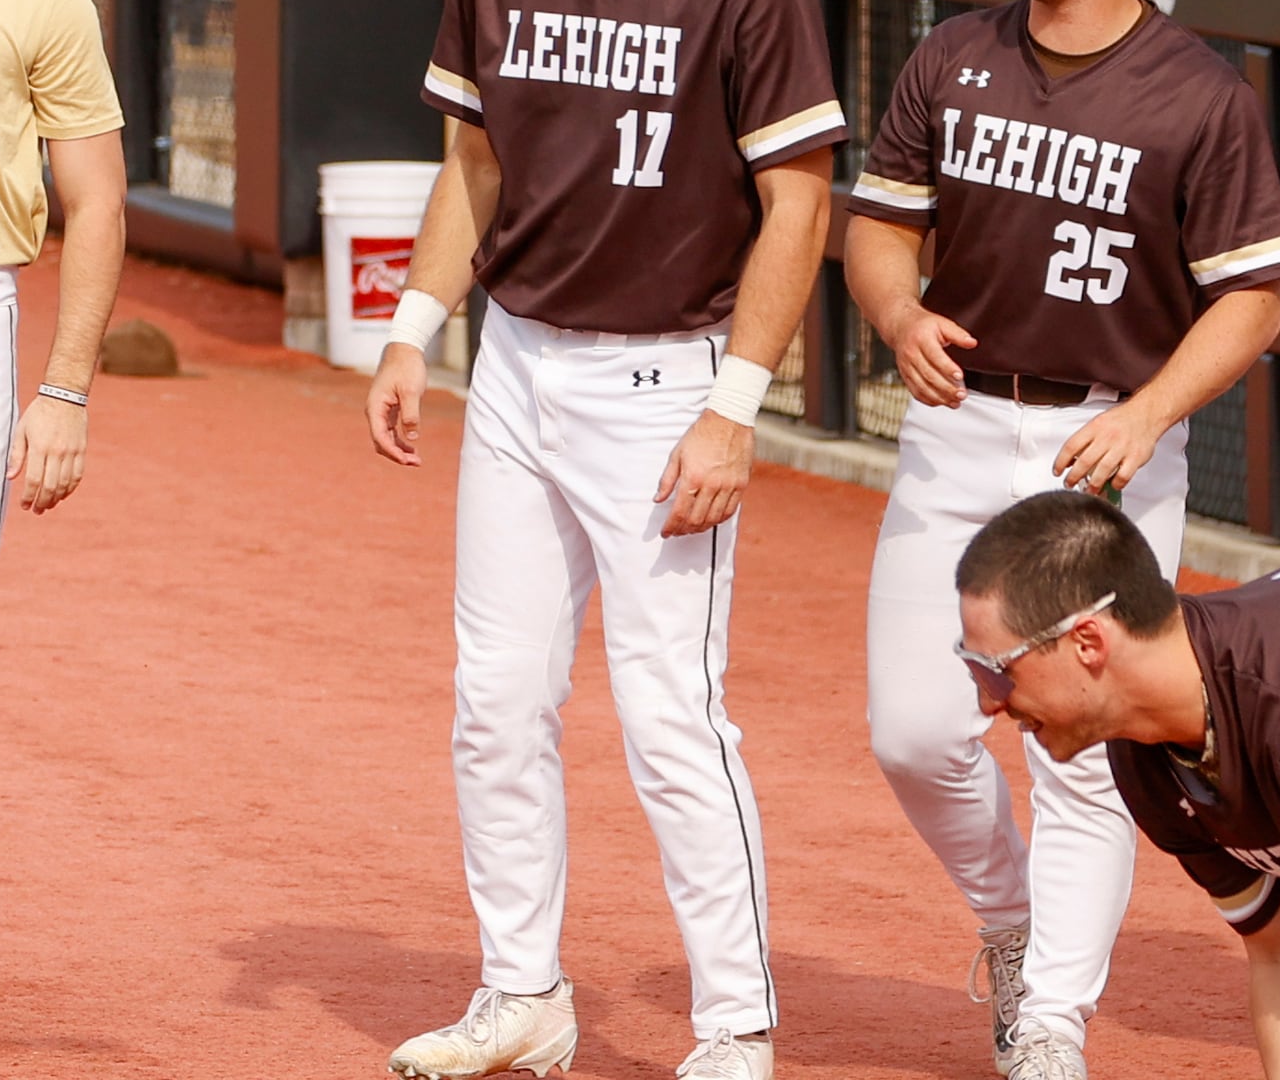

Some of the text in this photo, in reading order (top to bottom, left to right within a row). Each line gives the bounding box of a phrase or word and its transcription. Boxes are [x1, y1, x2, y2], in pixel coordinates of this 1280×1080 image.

[498, 9, 682, 96] LEHIGH
[612, 109, 673, 188] 17
[940, 107, 1142, 216] LEHIGH
[1044, 220, 1136, 305] 25
